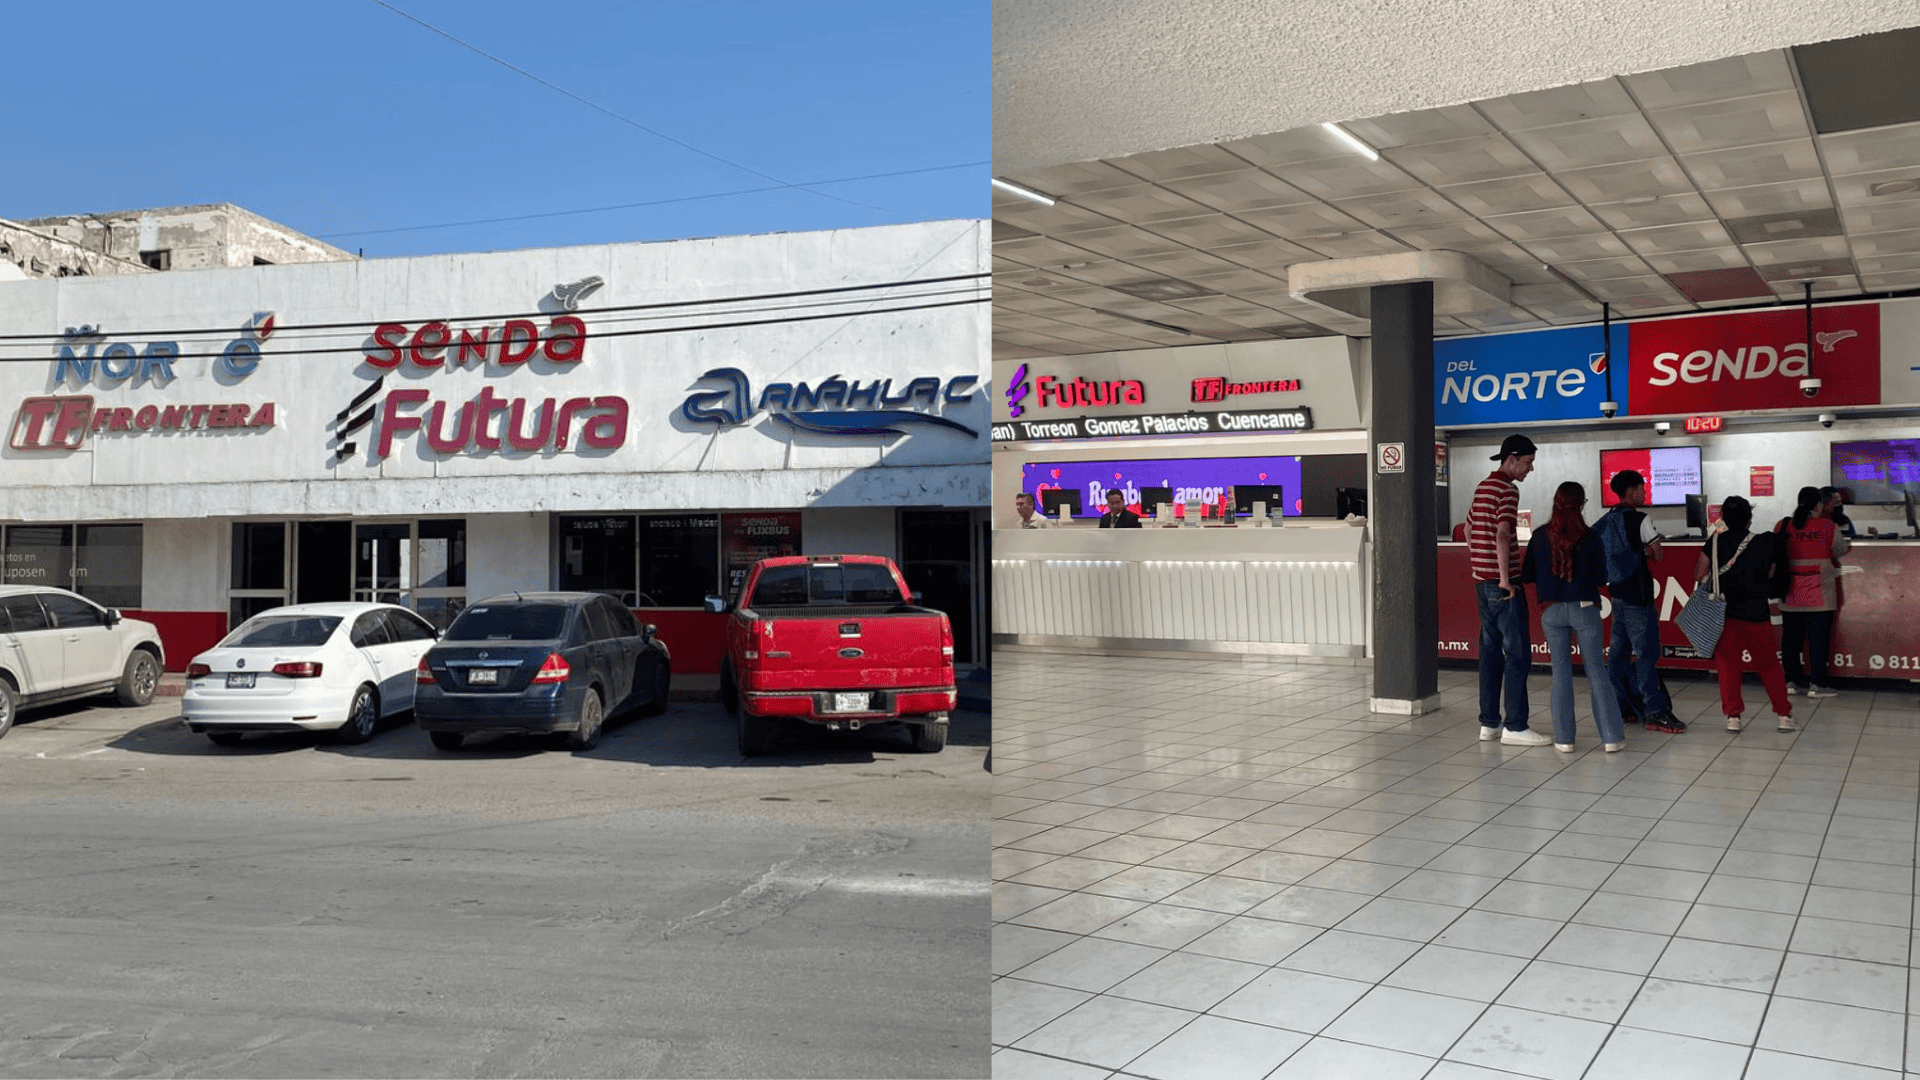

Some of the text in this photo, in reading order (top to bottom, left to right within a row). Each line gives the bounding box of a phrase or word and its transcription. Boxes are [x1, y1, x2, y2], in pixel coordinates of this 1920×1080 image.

[1035, 376, 1145, 408] Futura
[1196, 378, 1301, 400] TF FRONTERA
[22, 400, 277, 448] TF FRONTERA
[377, 386, 630, 458] Futura
[991, 410, 1306, 441] an) Torreon Gomez Palacios Cuencame
[1174, 486, 1224, 505] amor
